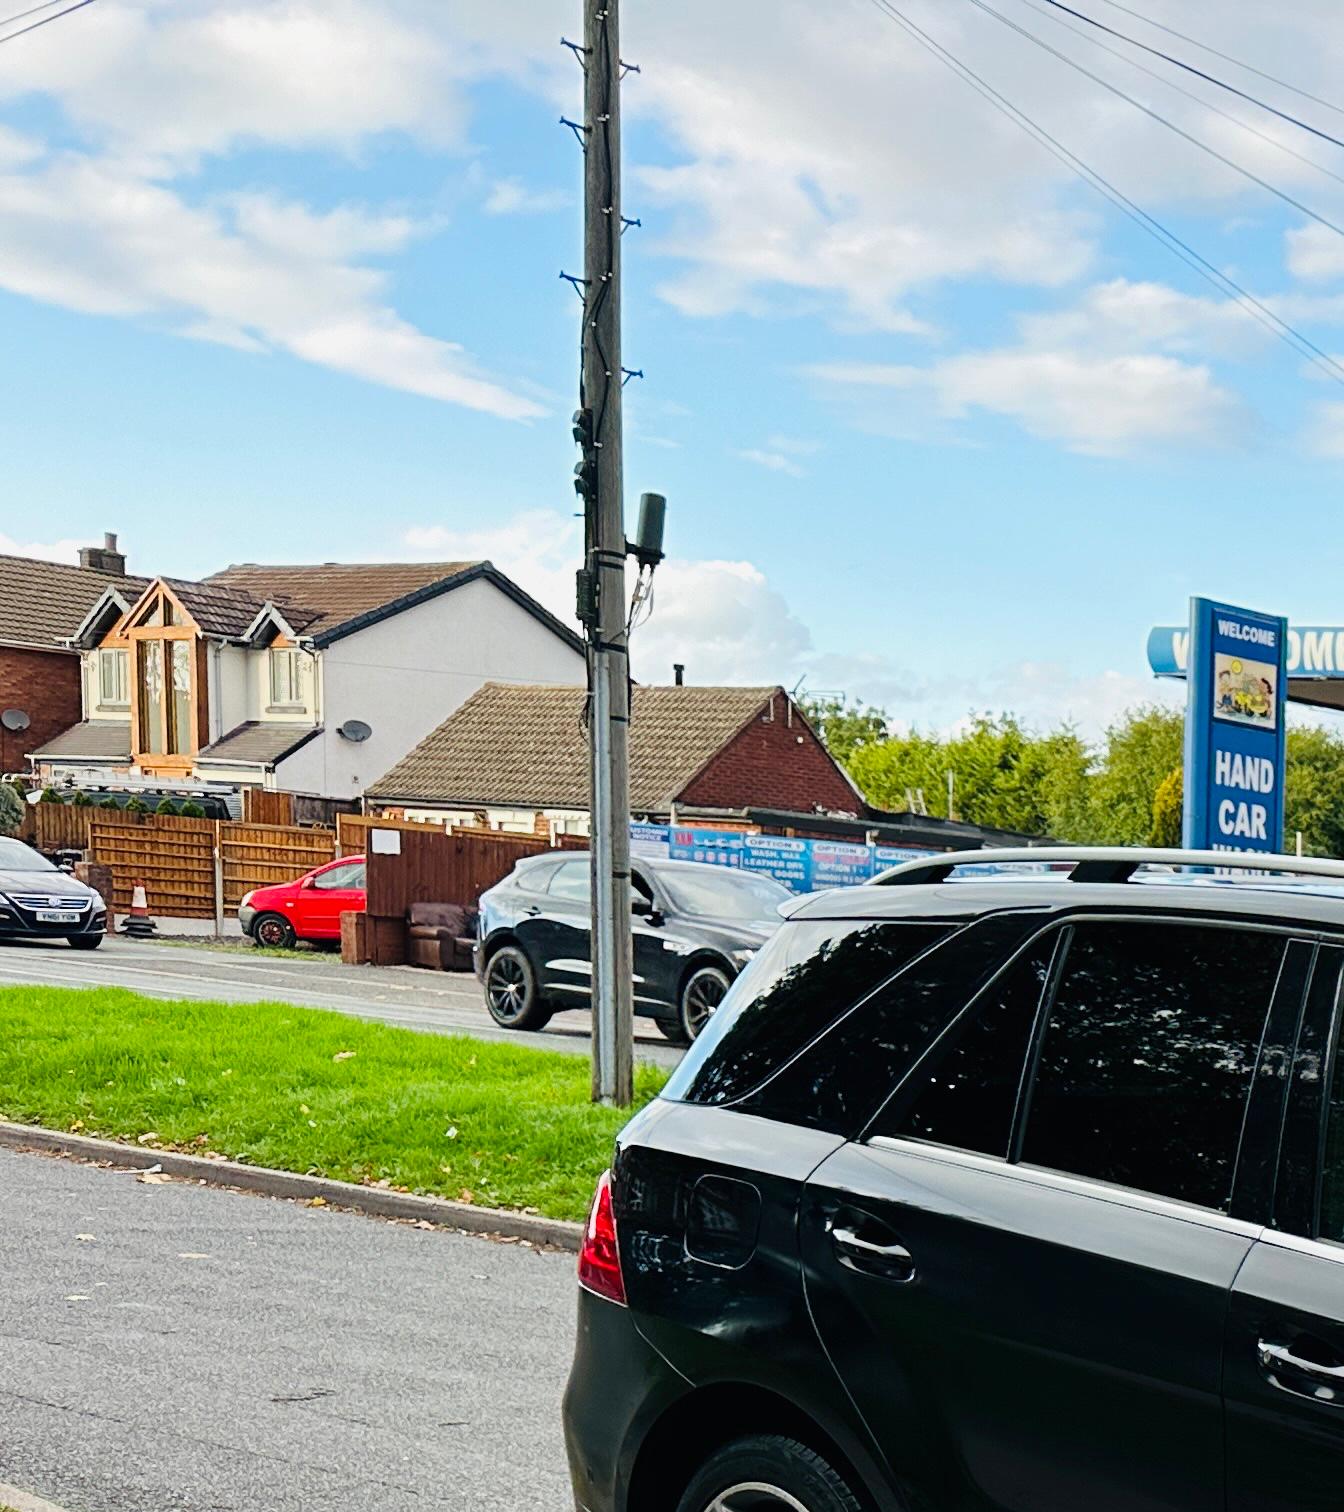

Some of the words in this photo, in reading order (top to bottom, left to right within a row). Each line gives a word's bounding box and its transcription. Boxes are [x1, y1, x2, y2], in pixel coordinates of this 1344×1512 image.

[1217, 618, 1276, 648] WELCOME
[1215, 749, 1275, 794] HAND
[1217, 798, 1268, 841] CAR
[749, 838, 791, 848] OPTION
[816, 844, 857, 854] OPTION
